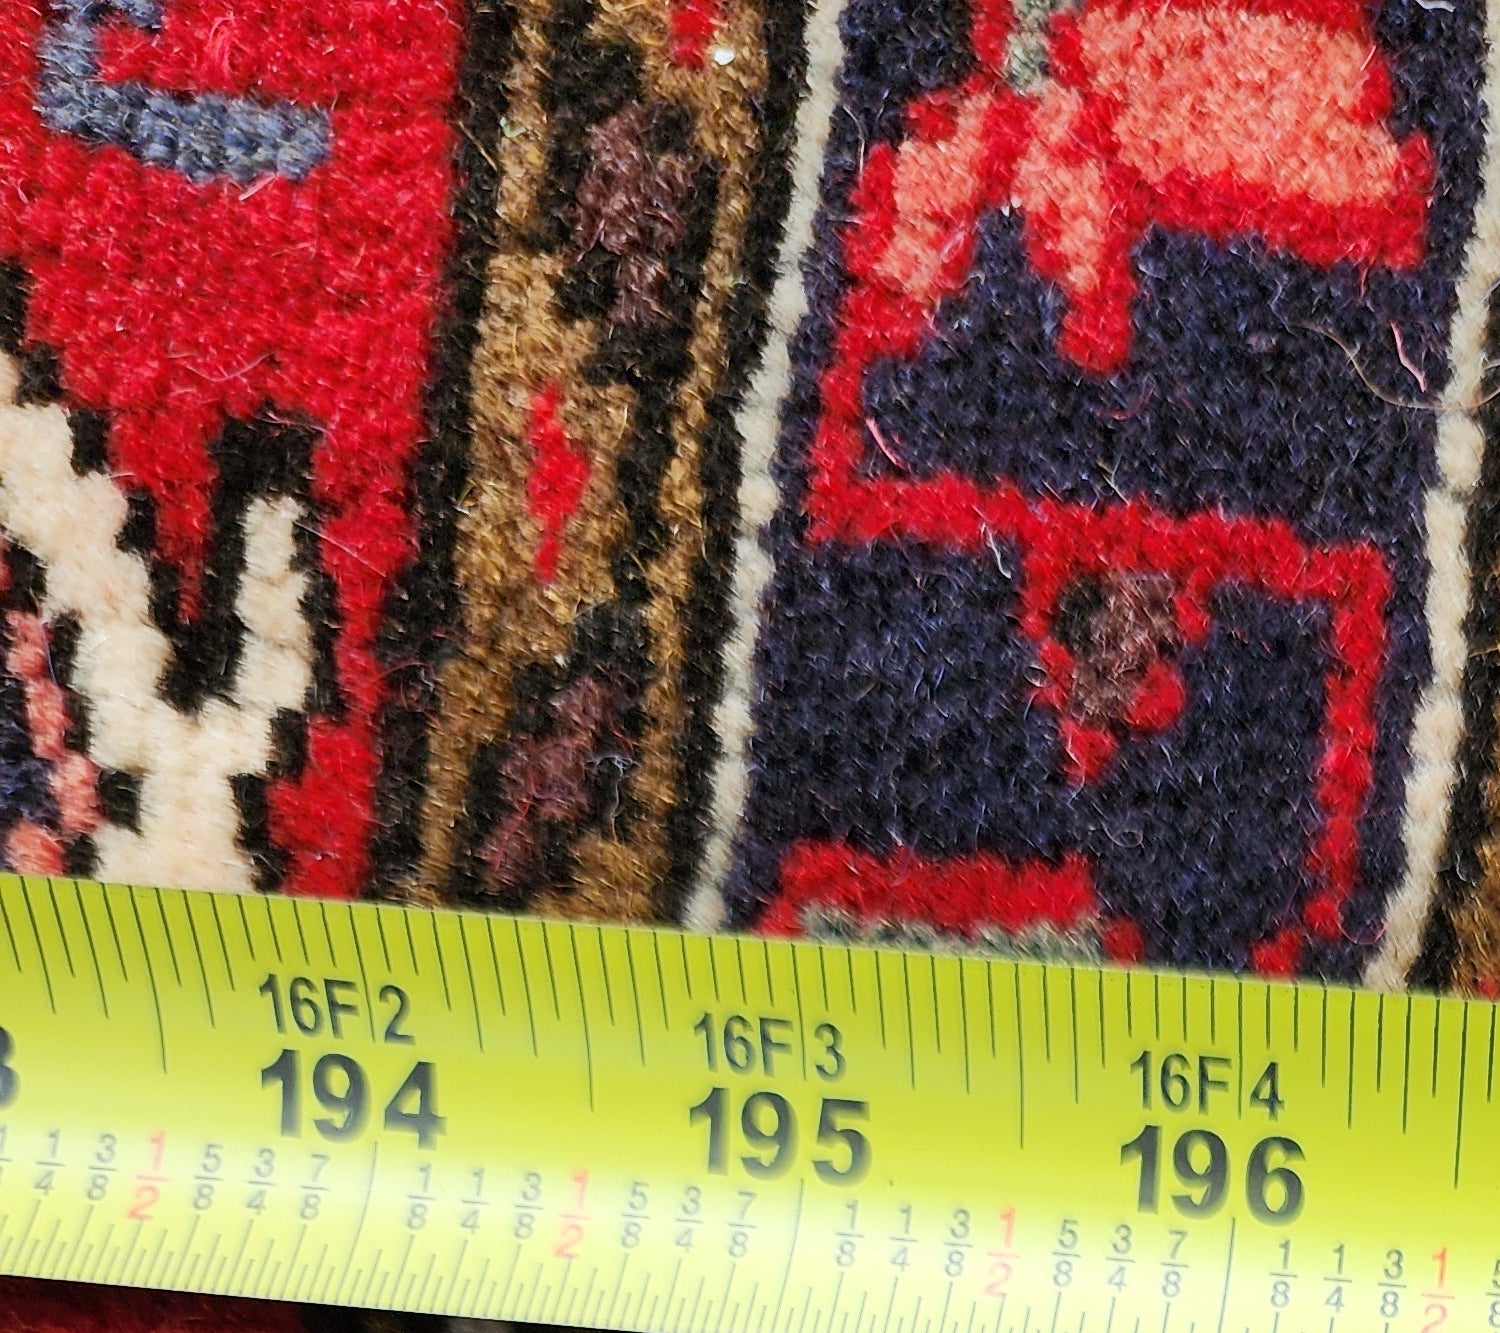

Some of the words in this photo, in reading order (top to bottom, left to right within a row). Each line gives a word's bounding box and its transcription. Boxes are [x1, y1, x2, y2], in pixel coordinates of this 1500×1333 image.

[261, 1048, 447, 1151] 194
[689, 1086, 872, 1187] 195
[1120, 1124, 1306, 1226] 196
